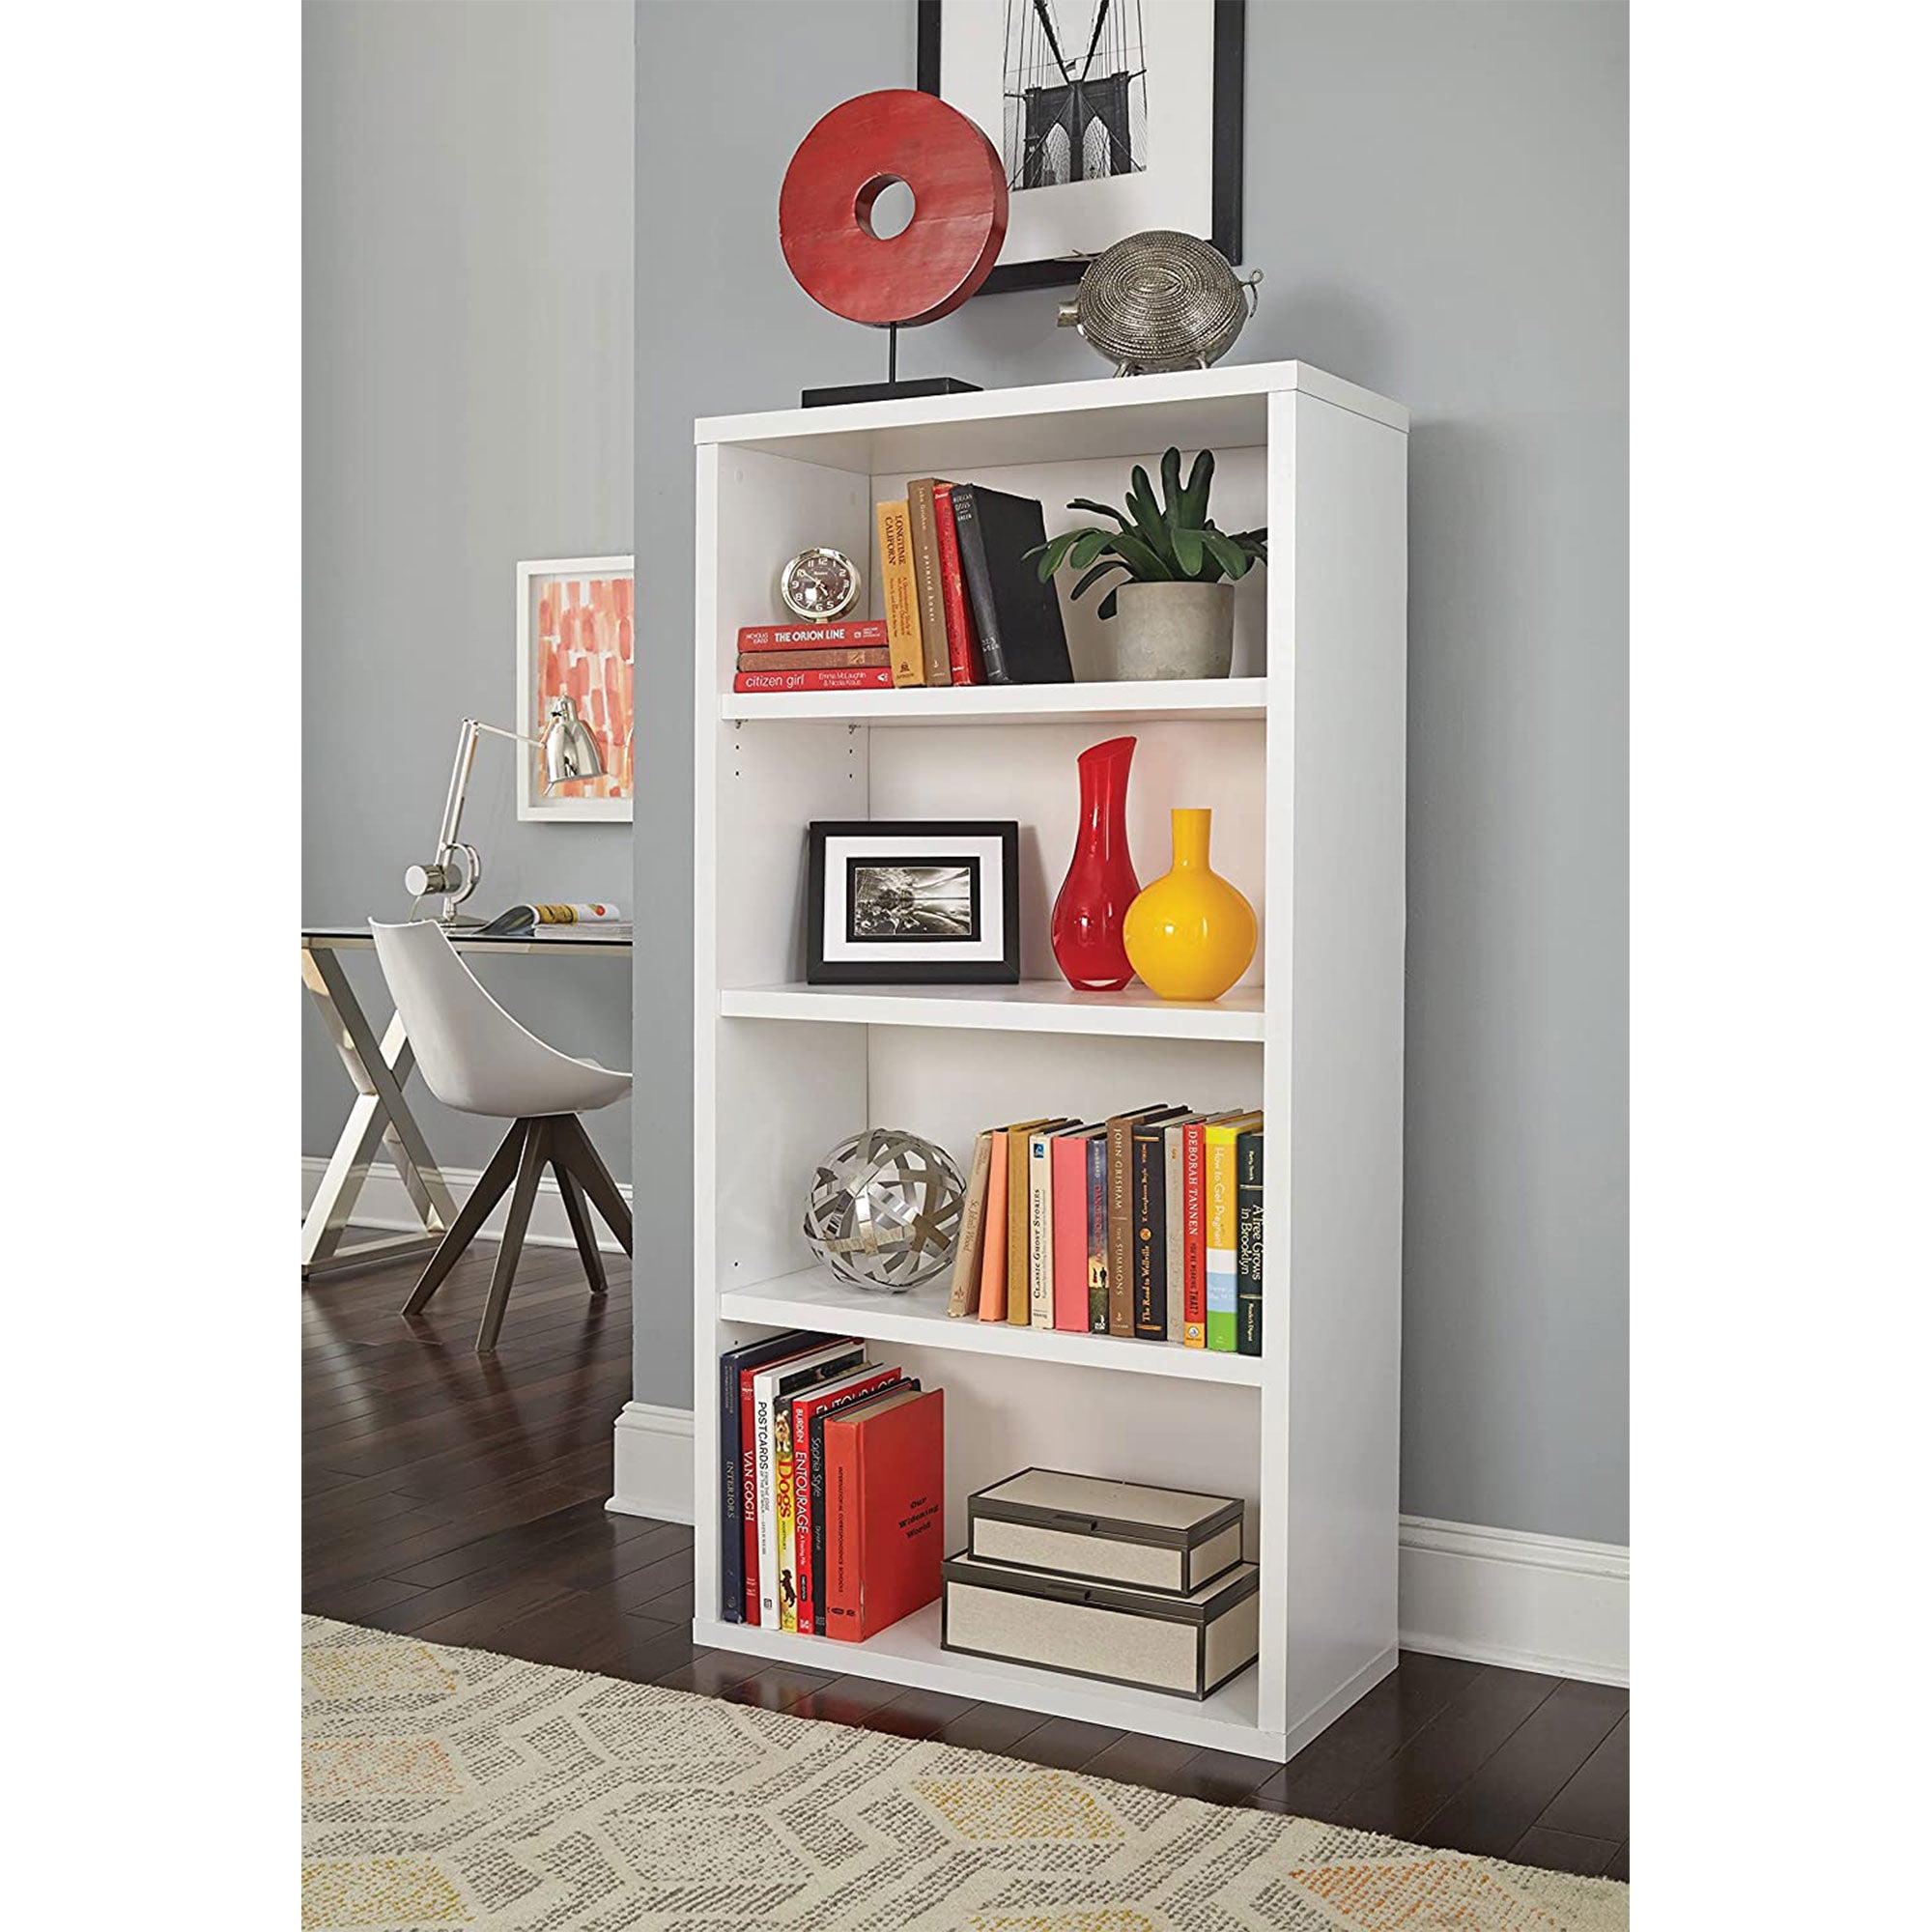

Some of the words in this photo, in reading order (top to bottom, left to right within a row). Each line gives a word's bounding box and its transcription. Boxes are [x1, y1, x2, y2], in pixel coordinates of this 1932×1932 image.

[895, 515, 906, 566] LONGTIME
[818, 557, 829, 566] 12
[838, 568, 846, 577] 2
[923, 554, 933, 591] painted
[792, 581, 800, 589] 9
[843, 580, 850, 588] 3
[806, 601, 813, 610] 7
[815, 603, 823, 611] 6
[775, 632, 790, 641] THE
[792, 630, 823, 641] ORION
[825, 629, 844, 639] LINE
[746, 676, 782, 688] citizen
[786, 674, 804, 688] girl
[1113, 1128, 1122, 1157] JOHN
[1188, 1130, 1198, 1184] DEBORAH
[1214, 1147, 1225, 1170] How
[1115, 1160, 1123, 1208] GRISHAM
[1215, 1171, 1223, 1180] to
[1214, 1182, 1225, 1202] Get
[1188, 1188, 1198, 1236] TANNEN
[1241, 1208, 1252, 1219] in
[1252, 1205, 1264, 1215] A
[1213, 1206, 1225, 1247] Pregnant
[1252, 1217, 1264, 1240] Tree
[1141, 1245, 1150, 1277] Wellville
[1238, 1222, 1252, 1275] Brooklyn
[1252, 1242, 1264, 1281] Grows
[1190, 1290, 1199, 1316] THAT?
[758, 1401, 768, 1470] POSTCARDS
[744, 1450, 753, 1478] VAN
[810, 1437, 821, 1472] Sophia
[726, 1461, 736, 1519] INTERIORS
[777, 1461, 794, 1518] Dogs
[794, 1451, 809, 1533] ENTOURAGE
[811, 1474, 823, 1497] Style
[744, 1480, 754, 1521] GOGH
[910, 1497, 926, 1509] Our
[906, 1520, 931, 1538] World
